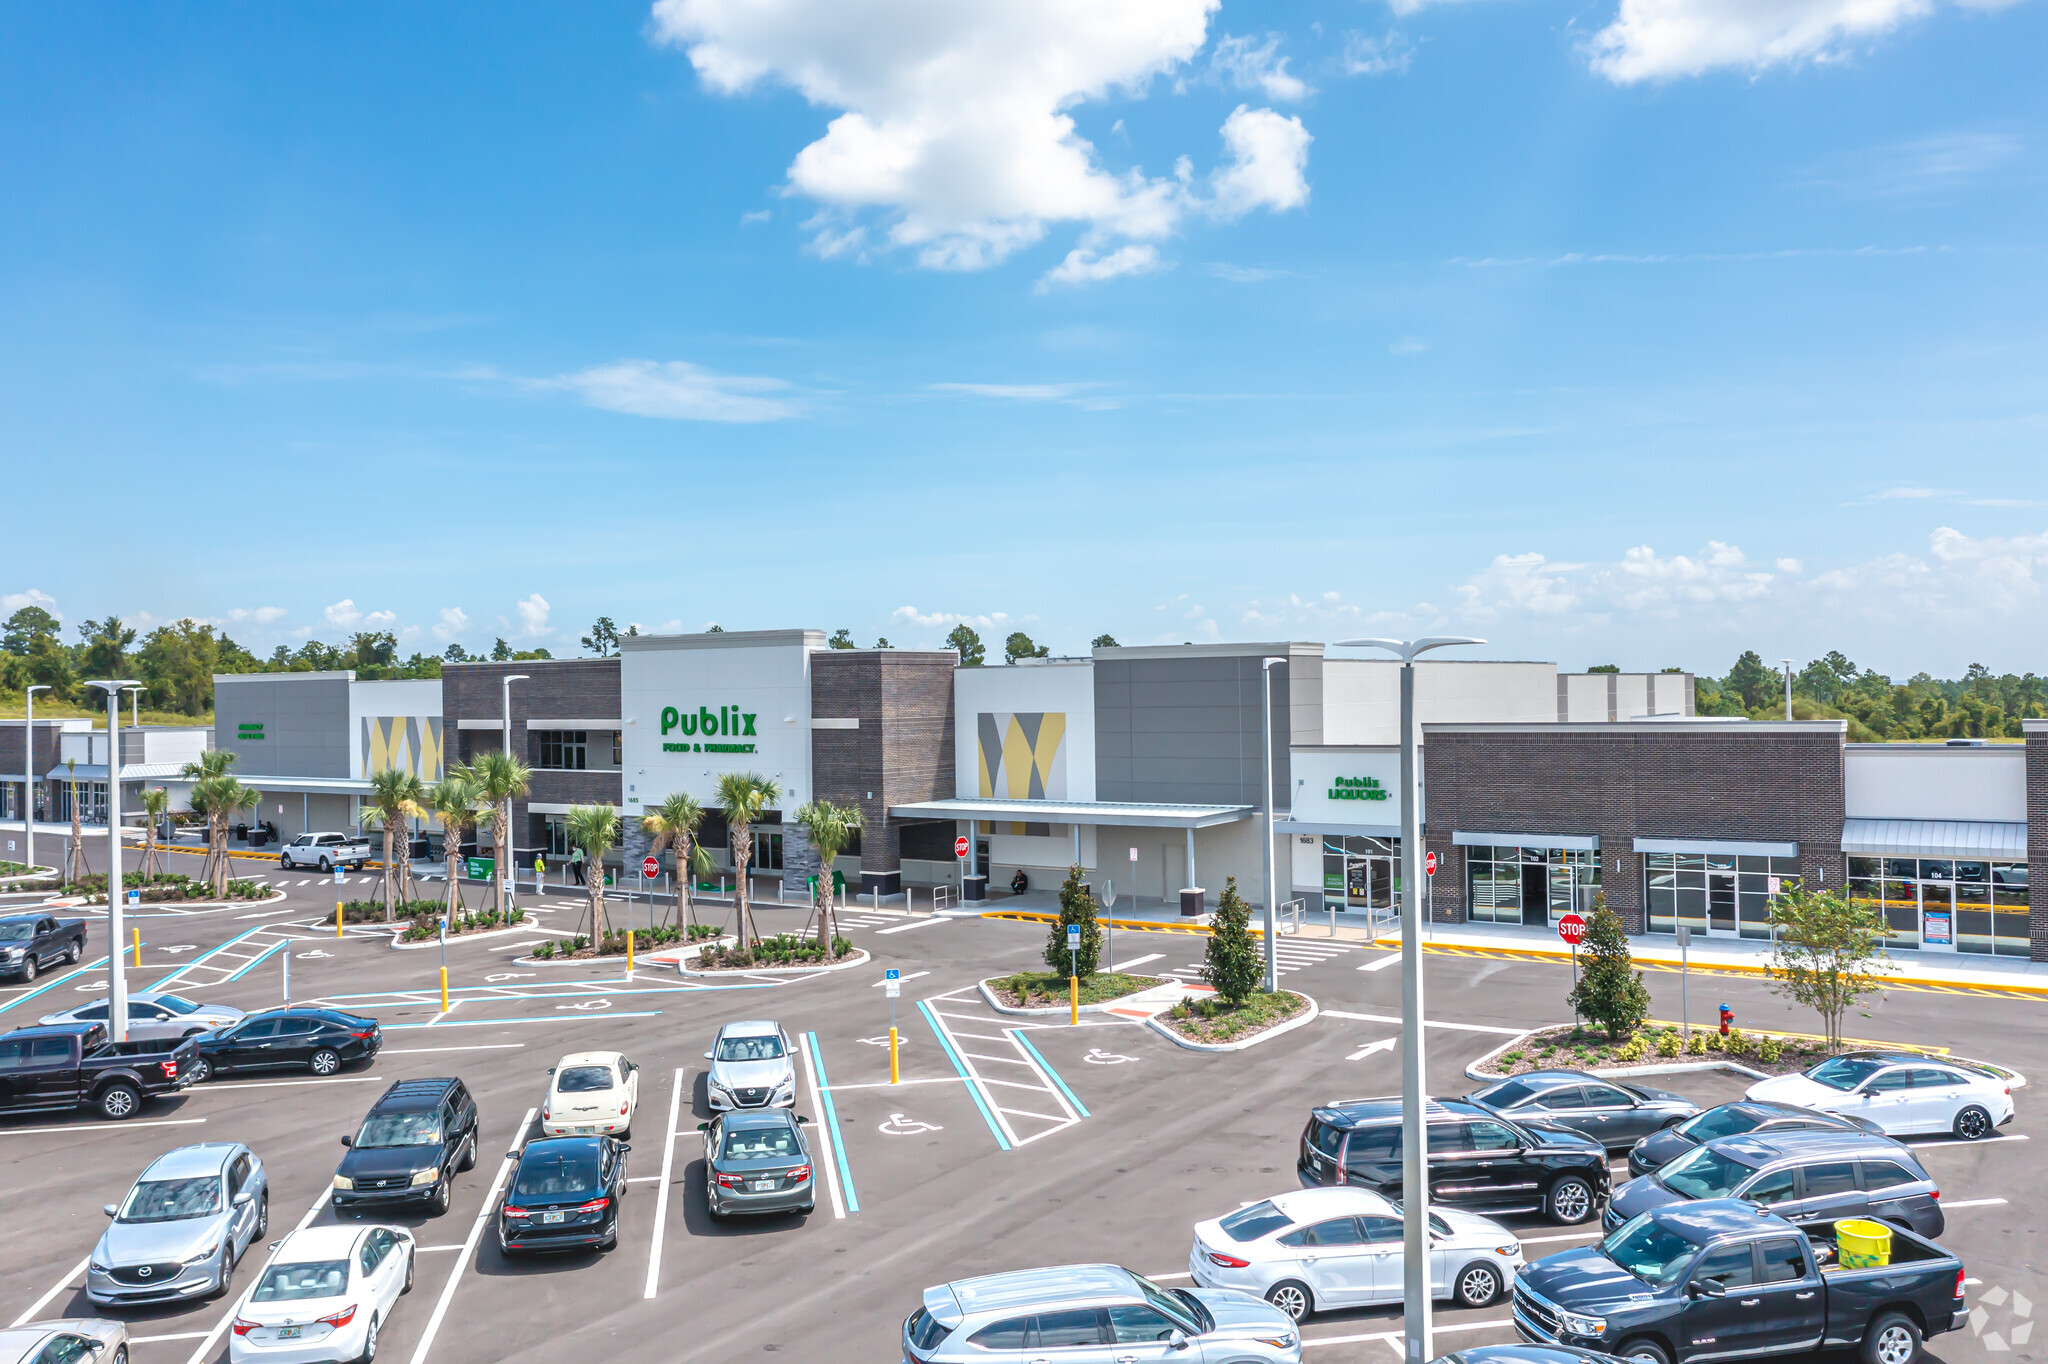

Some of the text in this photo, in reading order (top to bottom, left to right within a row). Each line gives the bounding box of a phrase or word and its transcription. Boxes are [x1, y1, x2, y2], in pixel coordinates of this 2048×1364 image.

[661, 705, 757, 736] Publix
[663, 743, 755, 753] FOOD & PHARMACY
[1335, 776, 1379, 788] Publix
[1327, 789, 1387, 801] LIQUORS
[956, 843, 968, 851] STOP
[643, 863, 658, 872] STOP
[1425, 860, 1436, 869] STOP
[1560, 923, 1586, 935] STOP
